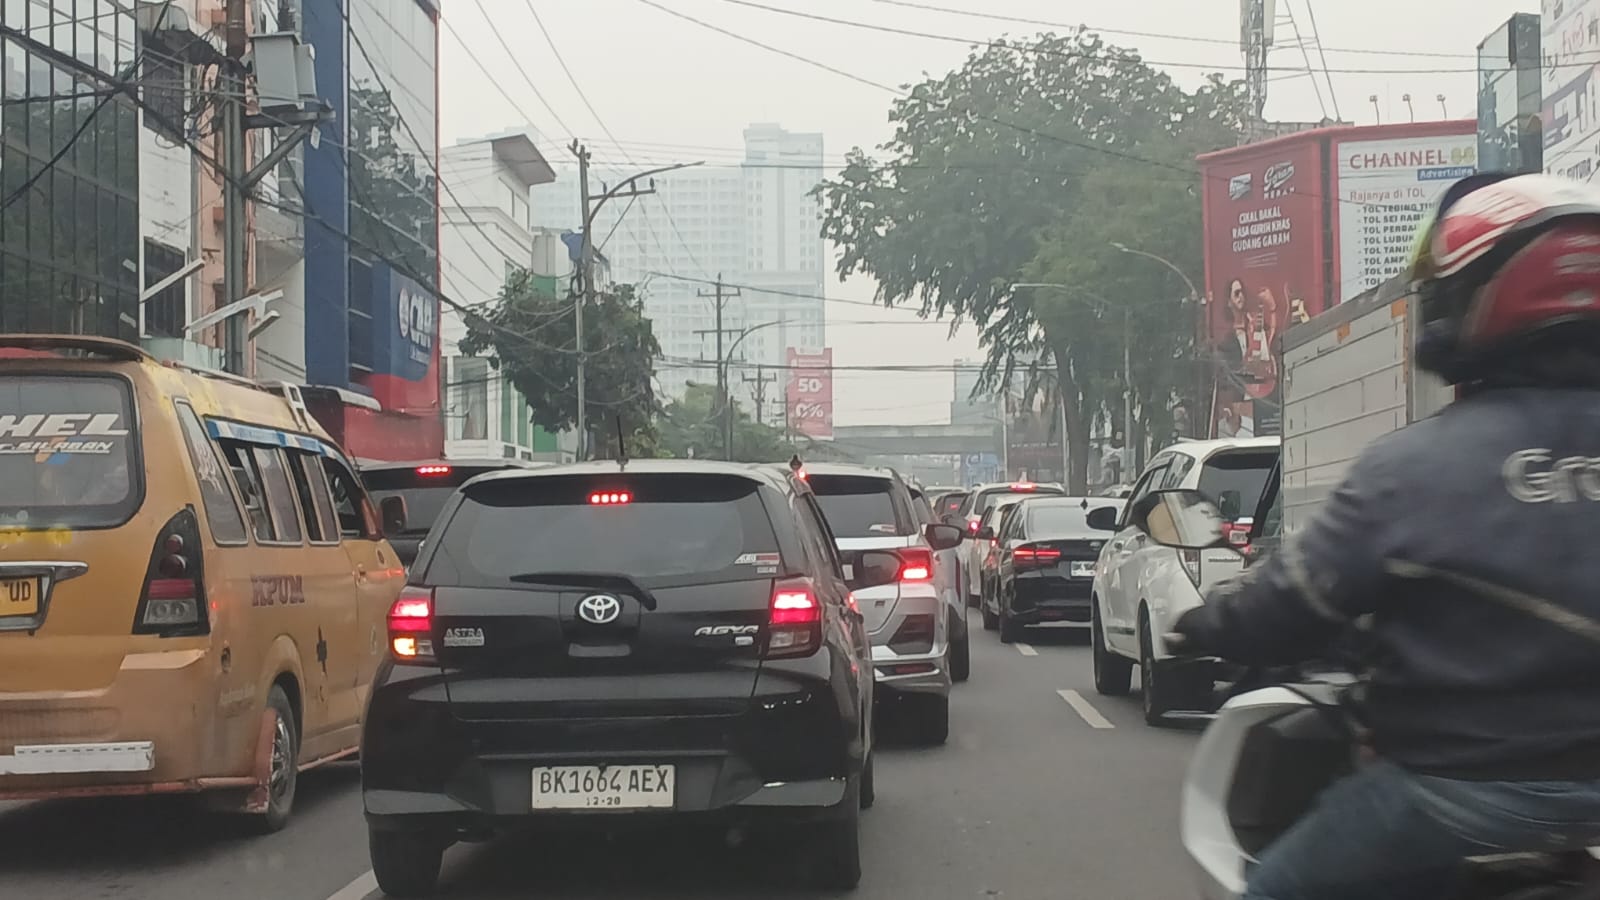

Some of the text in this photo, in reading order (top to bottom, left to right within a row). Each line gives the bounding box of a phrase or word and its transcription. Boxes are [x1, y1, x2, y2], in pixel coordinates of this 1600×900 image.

[1349, 149, 1448, 170] CHANNEL
[1350, 187, 1426, 202] Rajanya di TOL
[1363, 206, 1381, 214] TOL
[1363, 216, 1381, 224] TOL
[1363, 226, 1381, 235] TOL
[1262, 232, 1291, 248] GARAM
[1364, 237, 1381, 246] TOL
[1364, 247, 1382, 256] TOL
[1365, 258, 1382, 266] TOL
[1365, 268, 1382, 276] TOL
[250, 575, 305, 607] KPUM
[445, 628, 484, 638] ASTRA
[694, 625, 759, 636] AGYA
[628, 769, 669, 793] AEX
